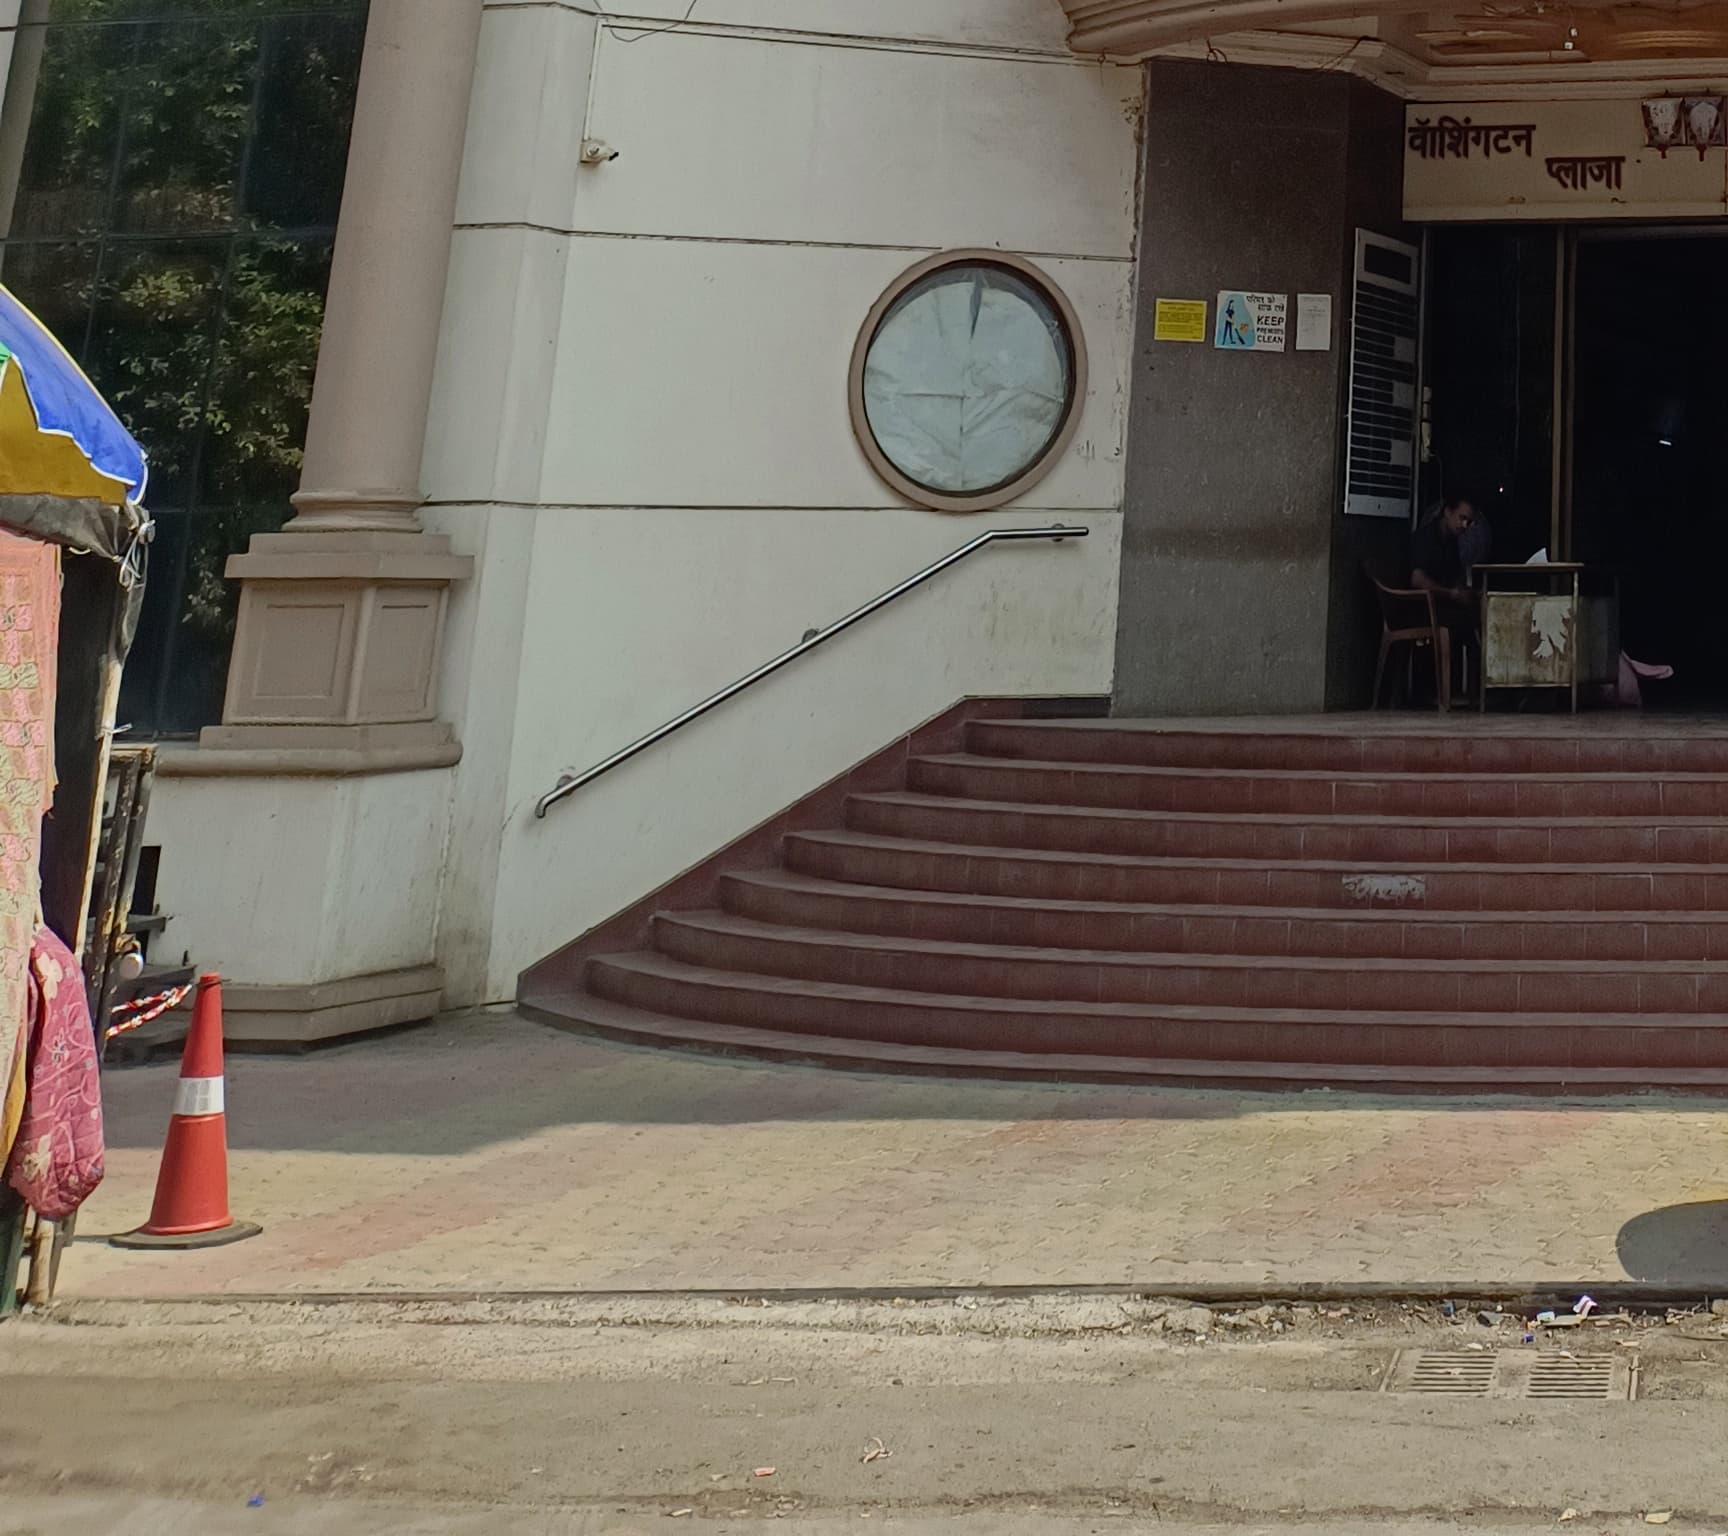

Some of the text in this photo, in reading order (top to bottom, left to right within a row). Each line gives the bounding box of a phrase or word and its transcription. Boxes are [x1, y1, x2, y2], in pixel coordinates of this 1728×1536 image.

[1408, 115, 1537, 160] वॉशिंगटन
[1546, 156, 1627, 190] प्लाजा
[1256, 315, 1285, 326] KEEP
[1257, 335, 1283, 344] CLEAN
